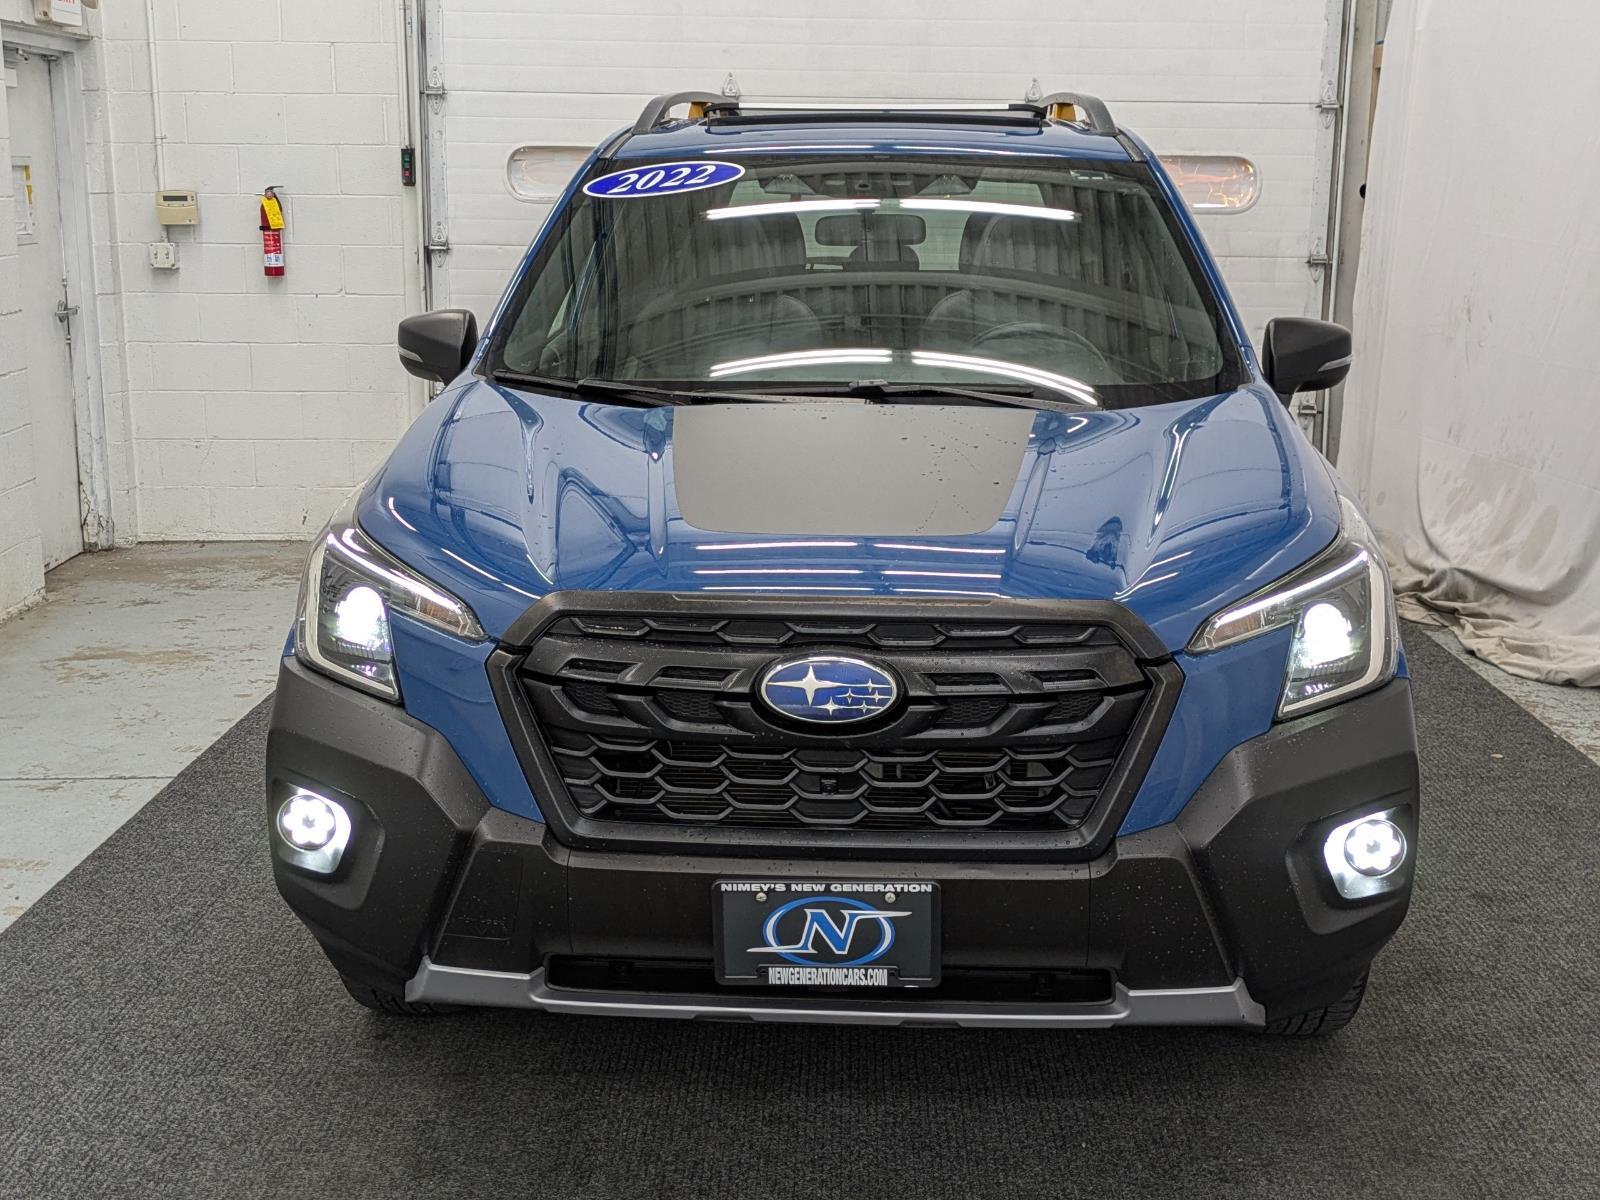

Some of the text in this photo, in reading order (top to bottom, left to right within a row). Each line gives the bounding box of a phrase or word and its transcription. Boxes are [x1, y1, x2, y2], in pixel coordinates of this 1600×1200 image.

[606, 165, 717, 195] 2022
[720, 883, 932, 893] NIMEY'S NEW GENERATION
[768, 967, 888, 986] NEWGENERATIONCARS.COM
